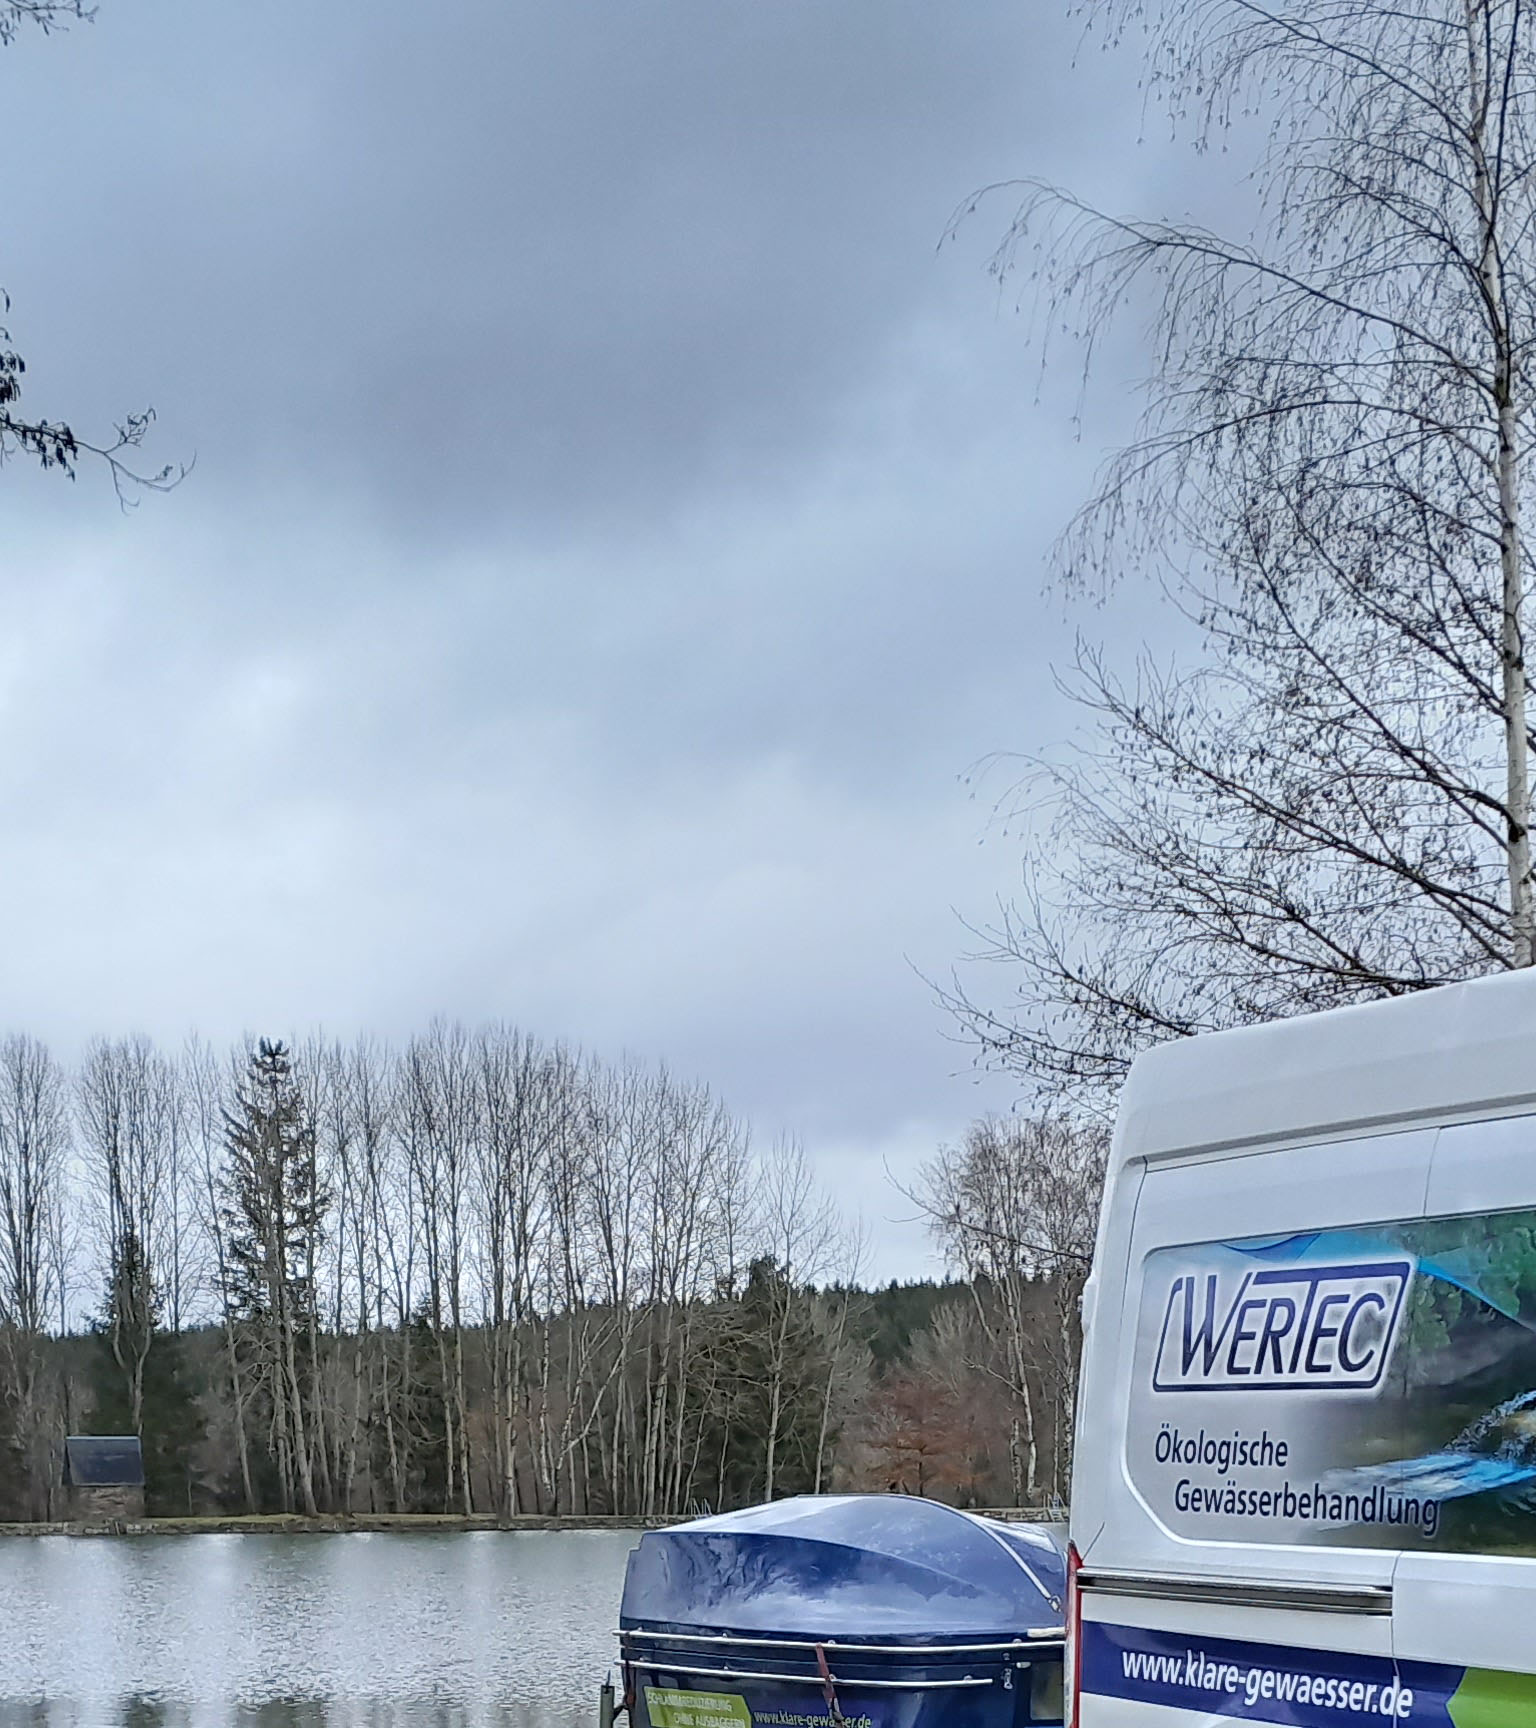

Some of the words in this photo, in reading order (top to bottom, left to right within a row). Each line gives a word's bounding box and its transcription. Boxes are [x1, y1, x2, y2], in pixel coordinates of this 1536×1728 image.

[1178, 1264, 1396, 1377] WERTEC
[1155, 1423, 1289, 1475] Ökologische
[1175, 1479, 1441, 1536] Gewässerbehandlung
[1122, 1649, 1413, 1718] www.klare-gewaesser.de
